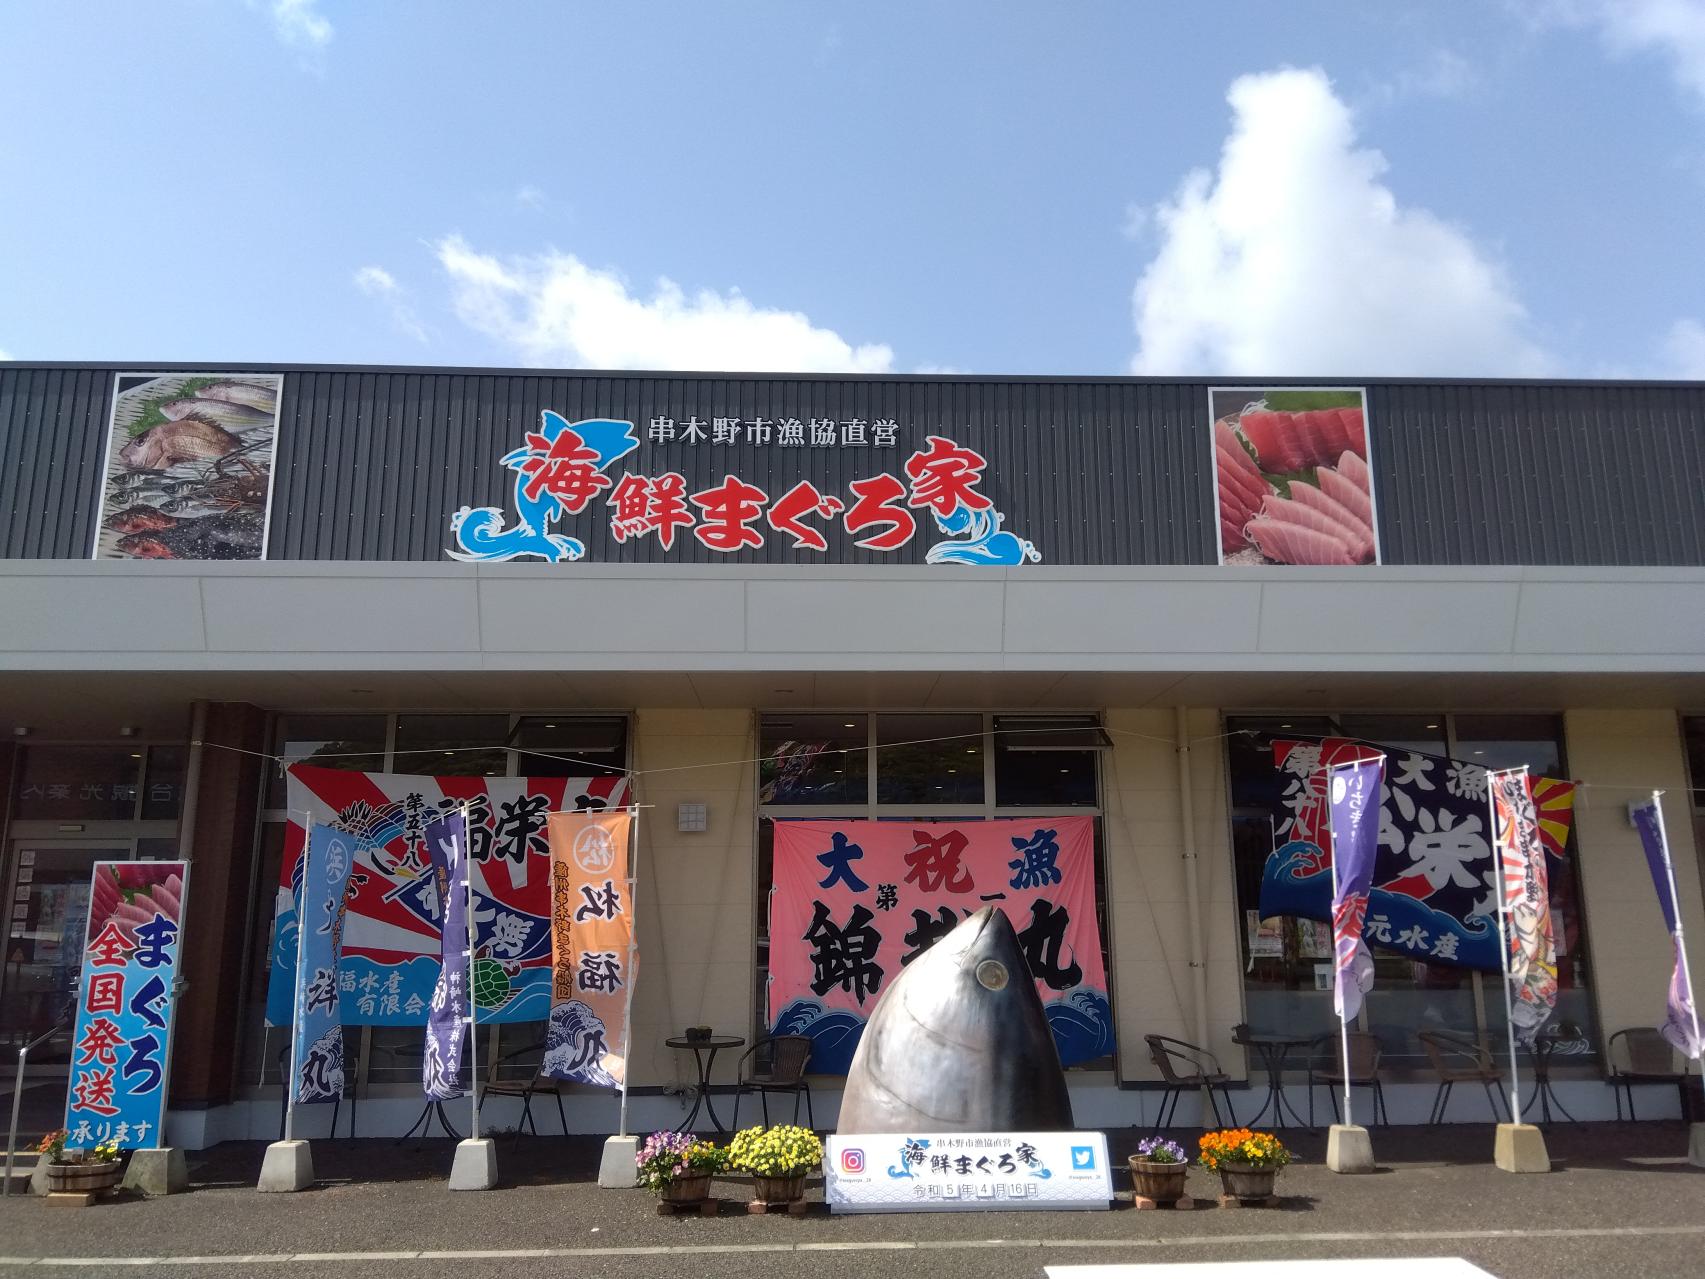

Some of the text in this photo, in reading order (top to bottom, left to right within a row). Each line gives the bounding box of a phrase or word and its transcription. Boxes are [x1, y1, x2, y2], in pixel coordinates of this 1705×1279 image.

[648, 416, 900, 449] 串木野市漁協直営
[521, 427, 994, 552] 海鮮まぐろ家
[70, 923, 136, 1116] 全国発送
[122, 911, 180, 1096] まぐろ
[356, 993, 436, 1016] 有限会
[71, 1119, 152, 1144] 承ります
[936, 1137, 1012, 1149] 串木野市漁協直営
[904, 1141, 1040, 1176] 海鮮まぐろ家
